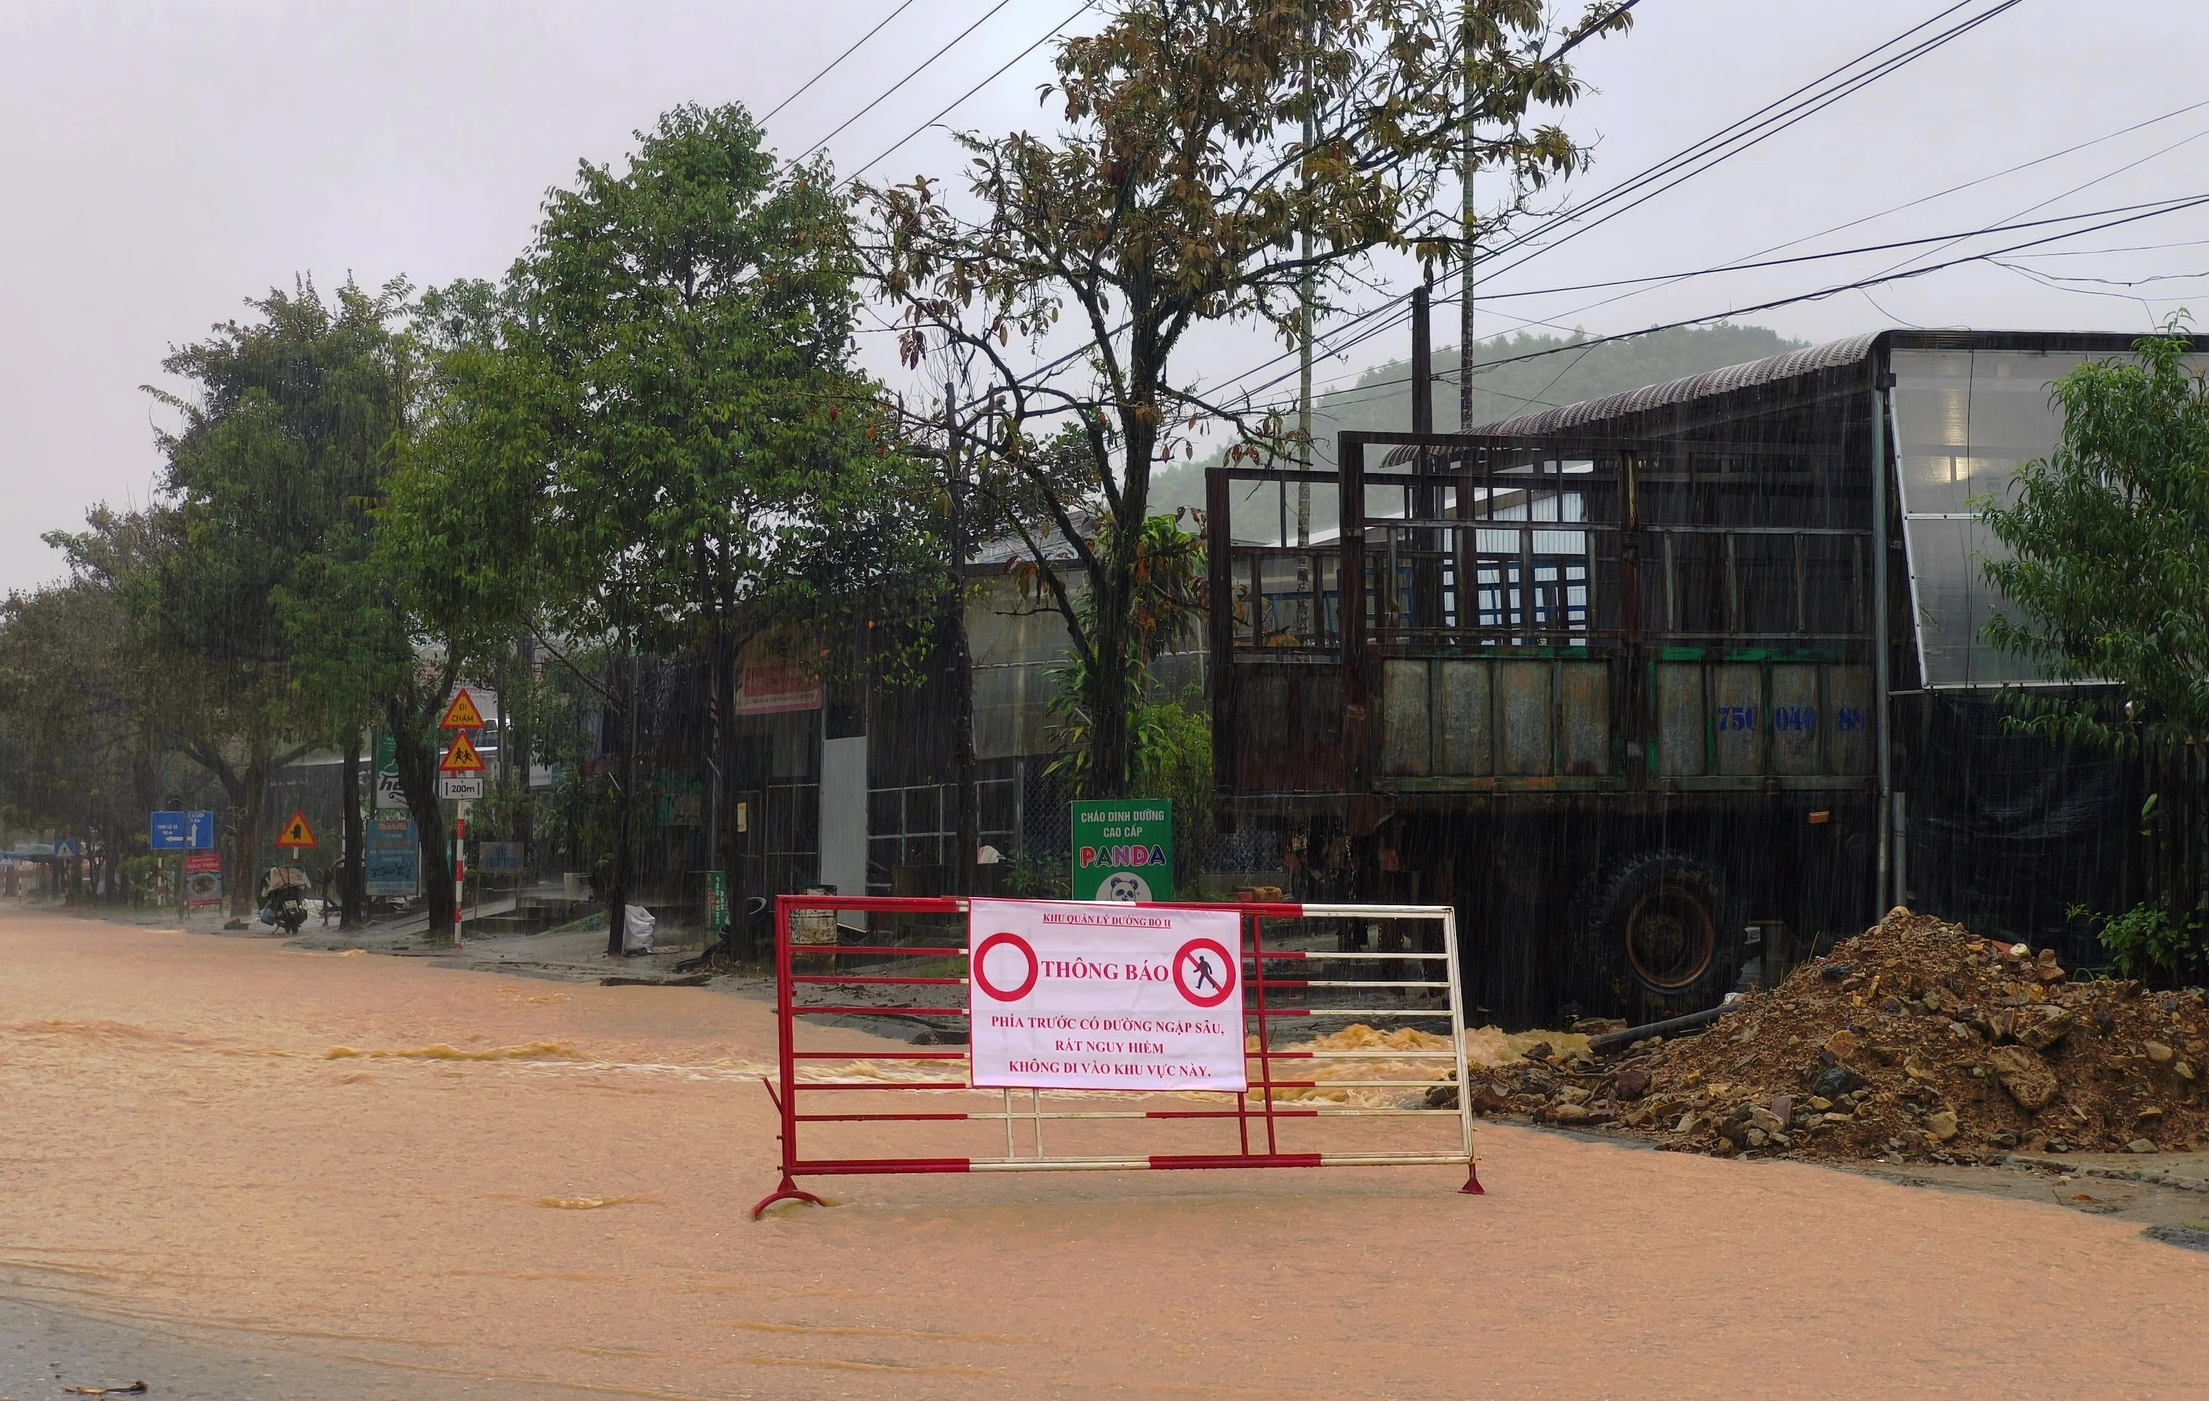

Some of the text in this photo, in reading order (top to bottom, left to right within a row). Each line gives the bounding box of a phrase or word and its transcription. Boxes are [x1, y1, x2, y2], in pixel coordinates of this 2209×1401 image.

[452, 784, 475, 793] 200m
[1081, 808, 1164, 823] CHÁO DINH DƯỠNG
[1103, 823, 1143, 838] CAO CẤP
[1080, 844, 1166, 869] PANDA
[1043, 914, 1064, 923] KHU
[1067, 913, 1095, 924] QUẢN
[1096, 914, 1109, 925] LÝ
[1041, 957, 1169, 981] THÔNG BÁO
[991, 1013, 1024, 1028] PHÍA
[1028, 1015, 1077, 1029] TRƯỚC
[1080, 1016, 1100, 1030] CÓ
[1155, 1021, 1192, 1035] NGẬP
[1195, 1020, 1225, 1036] SÂU,
[1055, 1037, 1164, 1054] RẤT NGUY HIỂM
[1009, 1058, 1060, 1073] KHÔNG
[1081, 1060, 1111, 1075] VÀO
[1114, 1064, 1143, 1075] KHU
[1147, 1063, 1176, 1078] VỰC
[1179, 1063, 1211, 1077] NÀY.
